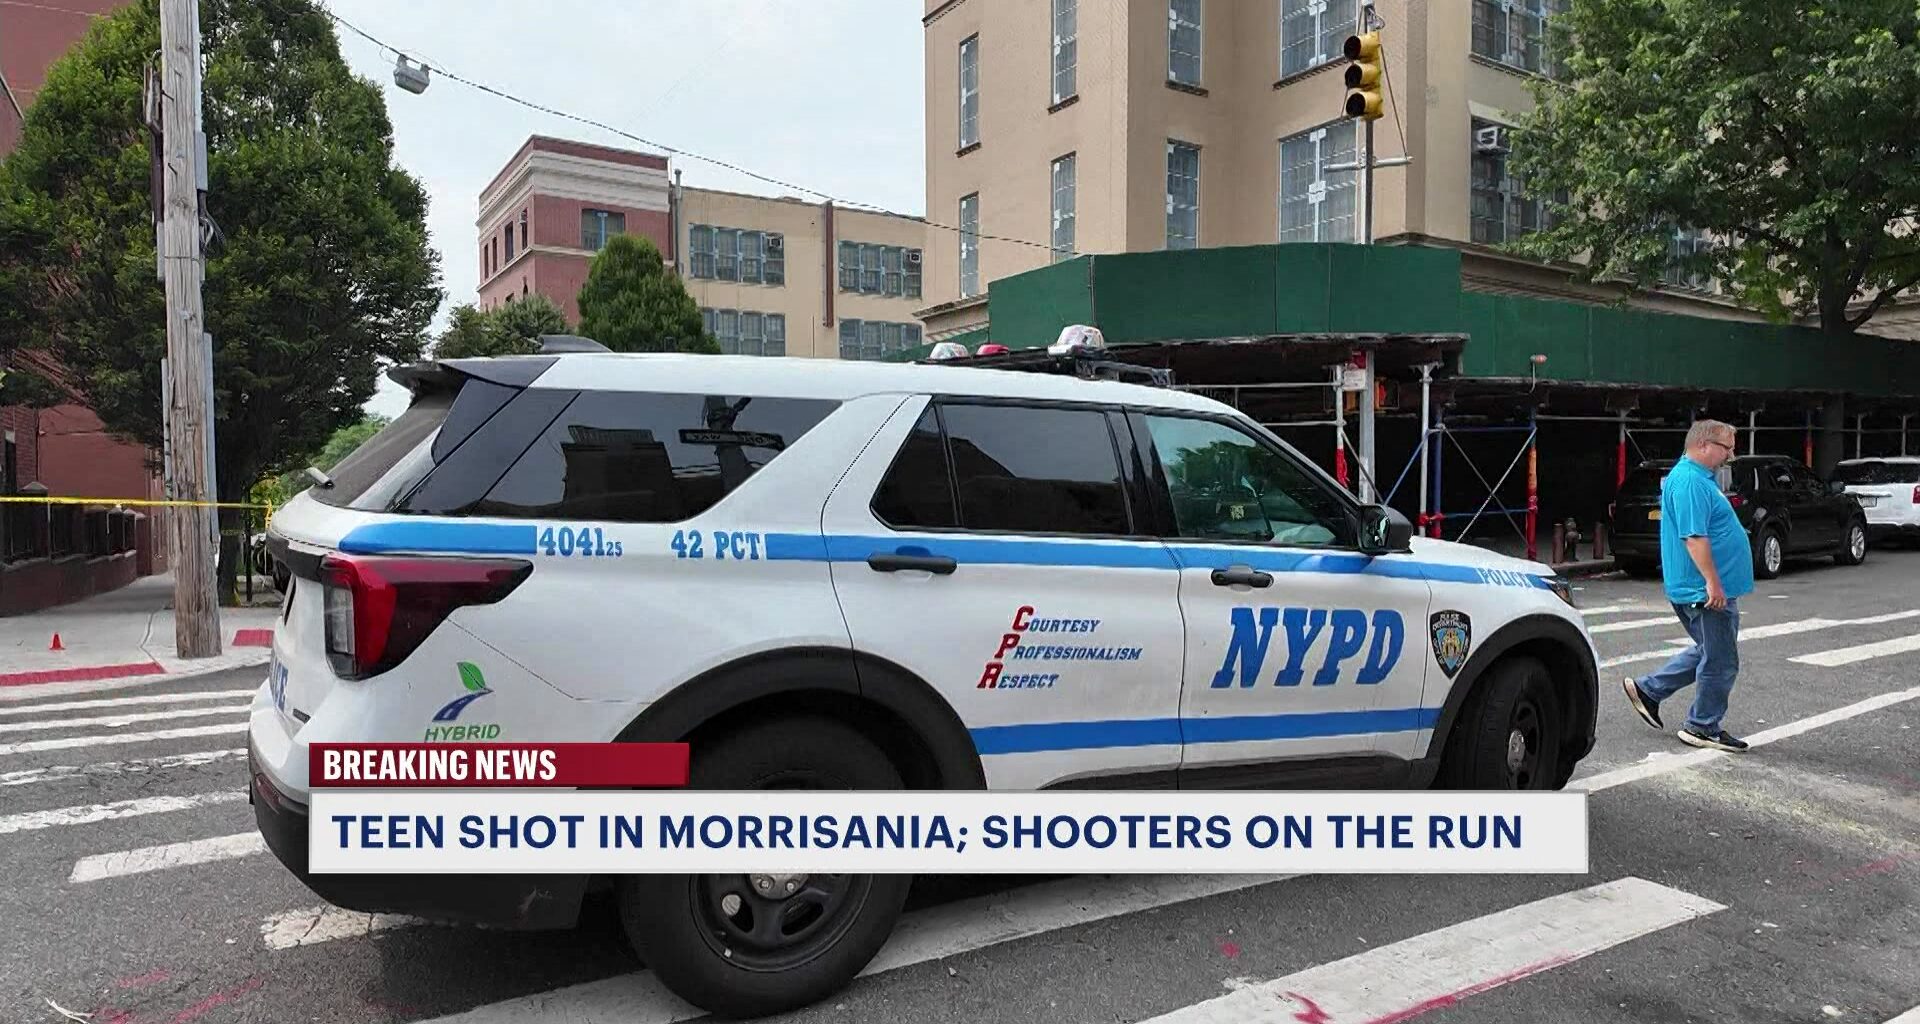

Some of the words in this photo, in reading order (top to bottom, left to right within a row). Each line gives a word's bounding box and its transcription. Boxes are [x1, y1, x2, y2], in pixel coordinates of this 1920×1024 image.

[539, 527, 605, 557] 4041
[606, 541, 623, 557] 25
[671, 529, 704, 559] 42
[713, 531, 760, 560] PCT
[1477, 567, 1534, 588] POLICE
[1012, 605, 1100, 633] COURTESY
[994, 634, 1143, 660] PROFESSIONALISM
[1211, 606, 1405, 689] NYPD
[977, 662, 1059, 689] RESPECT
[424, 724, 501, 742] HYBRID
